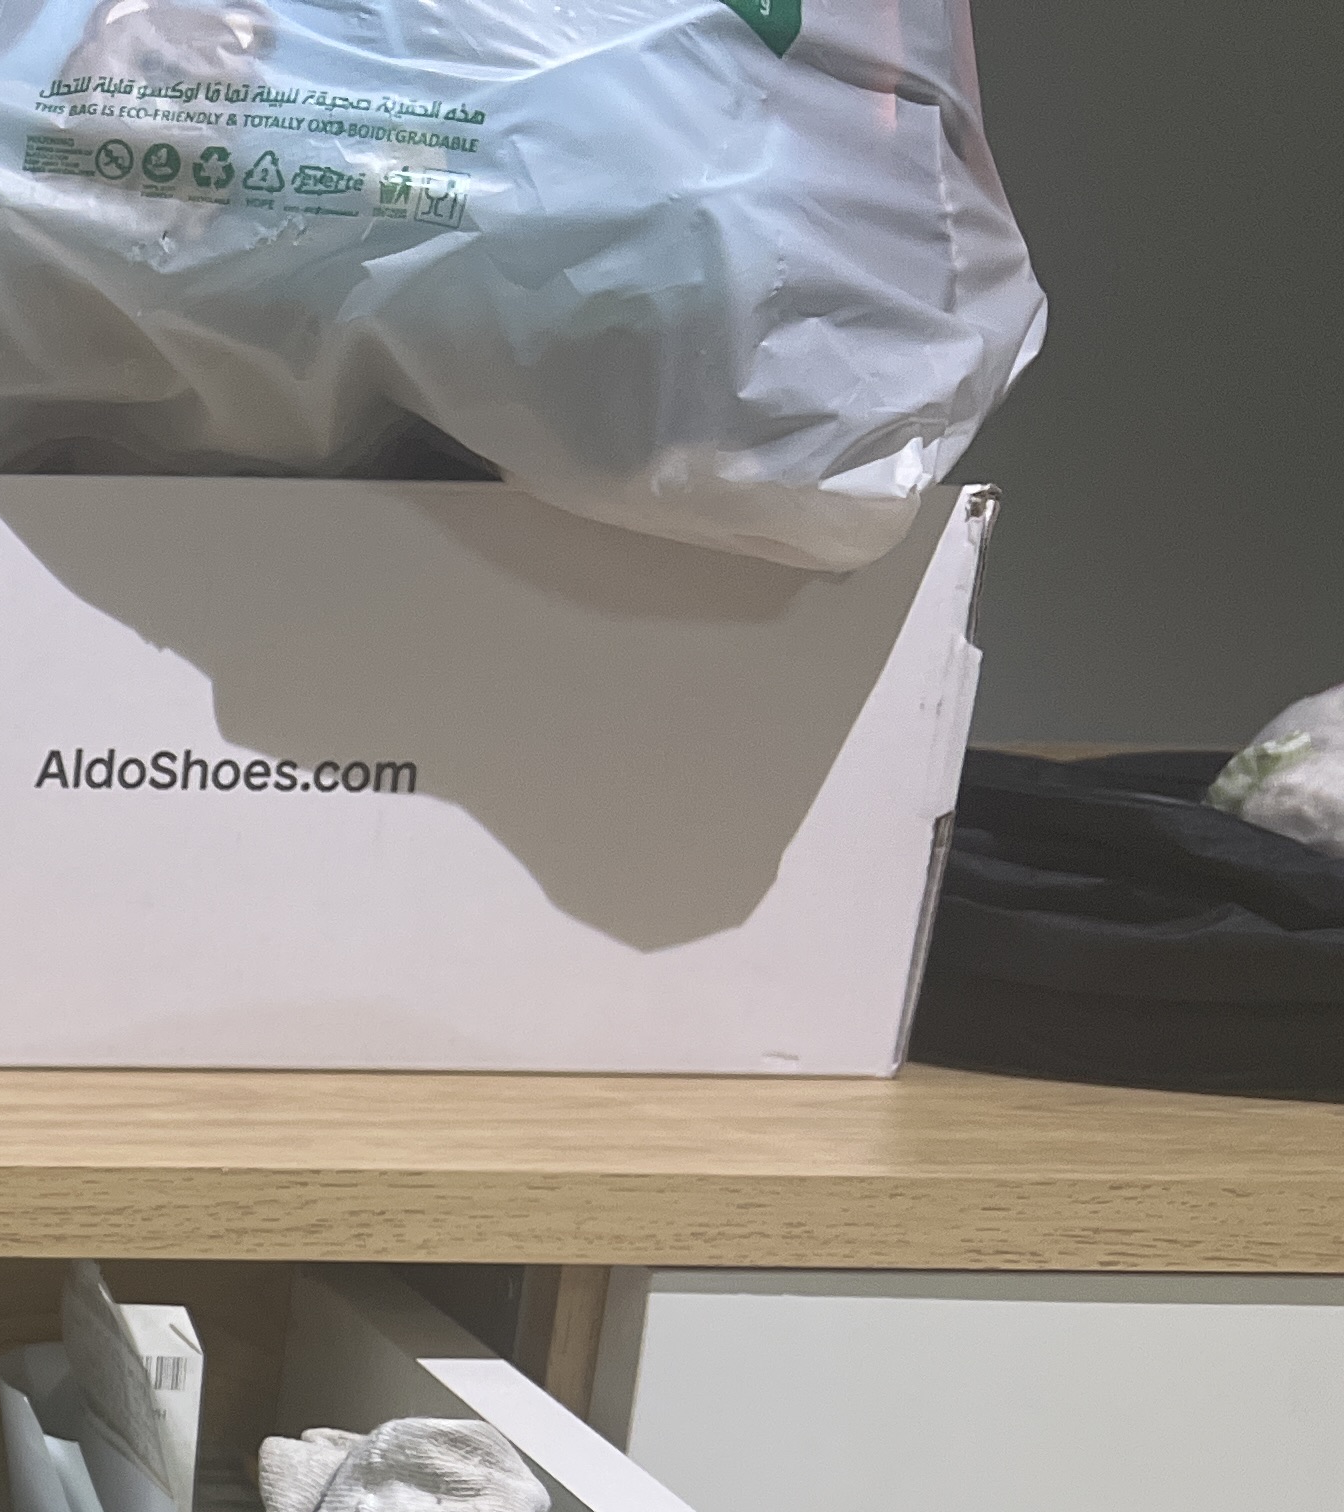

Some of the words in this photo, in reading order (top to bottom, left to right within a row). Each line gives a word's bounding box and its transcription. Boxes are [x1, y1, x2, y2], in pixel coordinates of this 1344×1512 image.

[35, 102, 65, 114] THIS
[68, 103, 98, 116] BAG
[101, 104, 114, 117] IS
[118, 105, 223, 125] ECO-FRIENDLY
[226, 113, 237, 126] &
[243, 114, 305, 130] TOTALLY
[34, 748, 417, 794] AldoShoes.com
